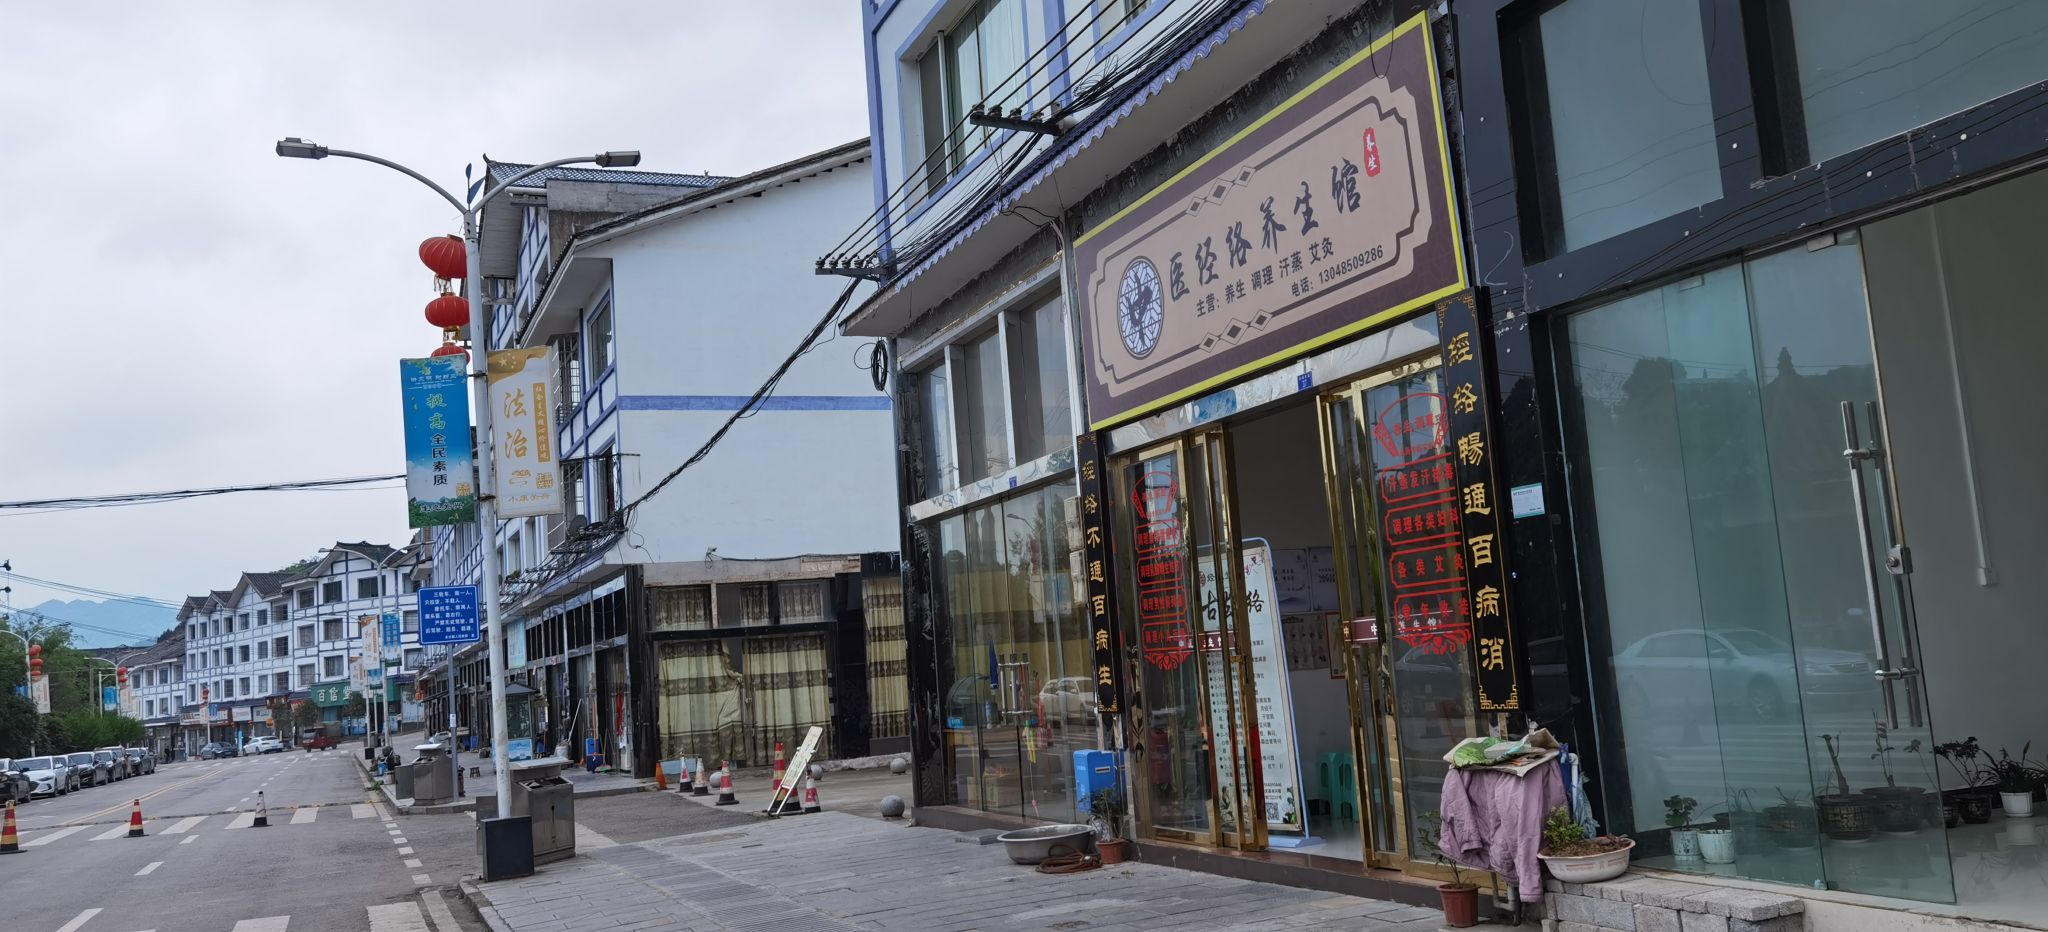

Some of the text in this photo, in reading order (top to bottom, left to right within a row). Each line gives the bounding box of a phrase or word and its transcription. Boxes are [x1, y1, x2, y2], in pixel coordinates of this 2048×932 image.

[1365, 133, 1378, 170] 养生
[1168, 157, 1362, 303] 医经络养生馆
[1318, 244, 1384, 284] 13048509286
[1225, 280, 1247, 306] 养生
[1251, 265, 1274, 291] 调理
[1278, 250, 1303, 279] 汗蒸
[1308, 236, 1334, 264] 艾灸
[426, 393, 448, 486] 提高全民素质
[504, 388, 527, 459] 法治
[317, 687, 352, 702] 百信堂
